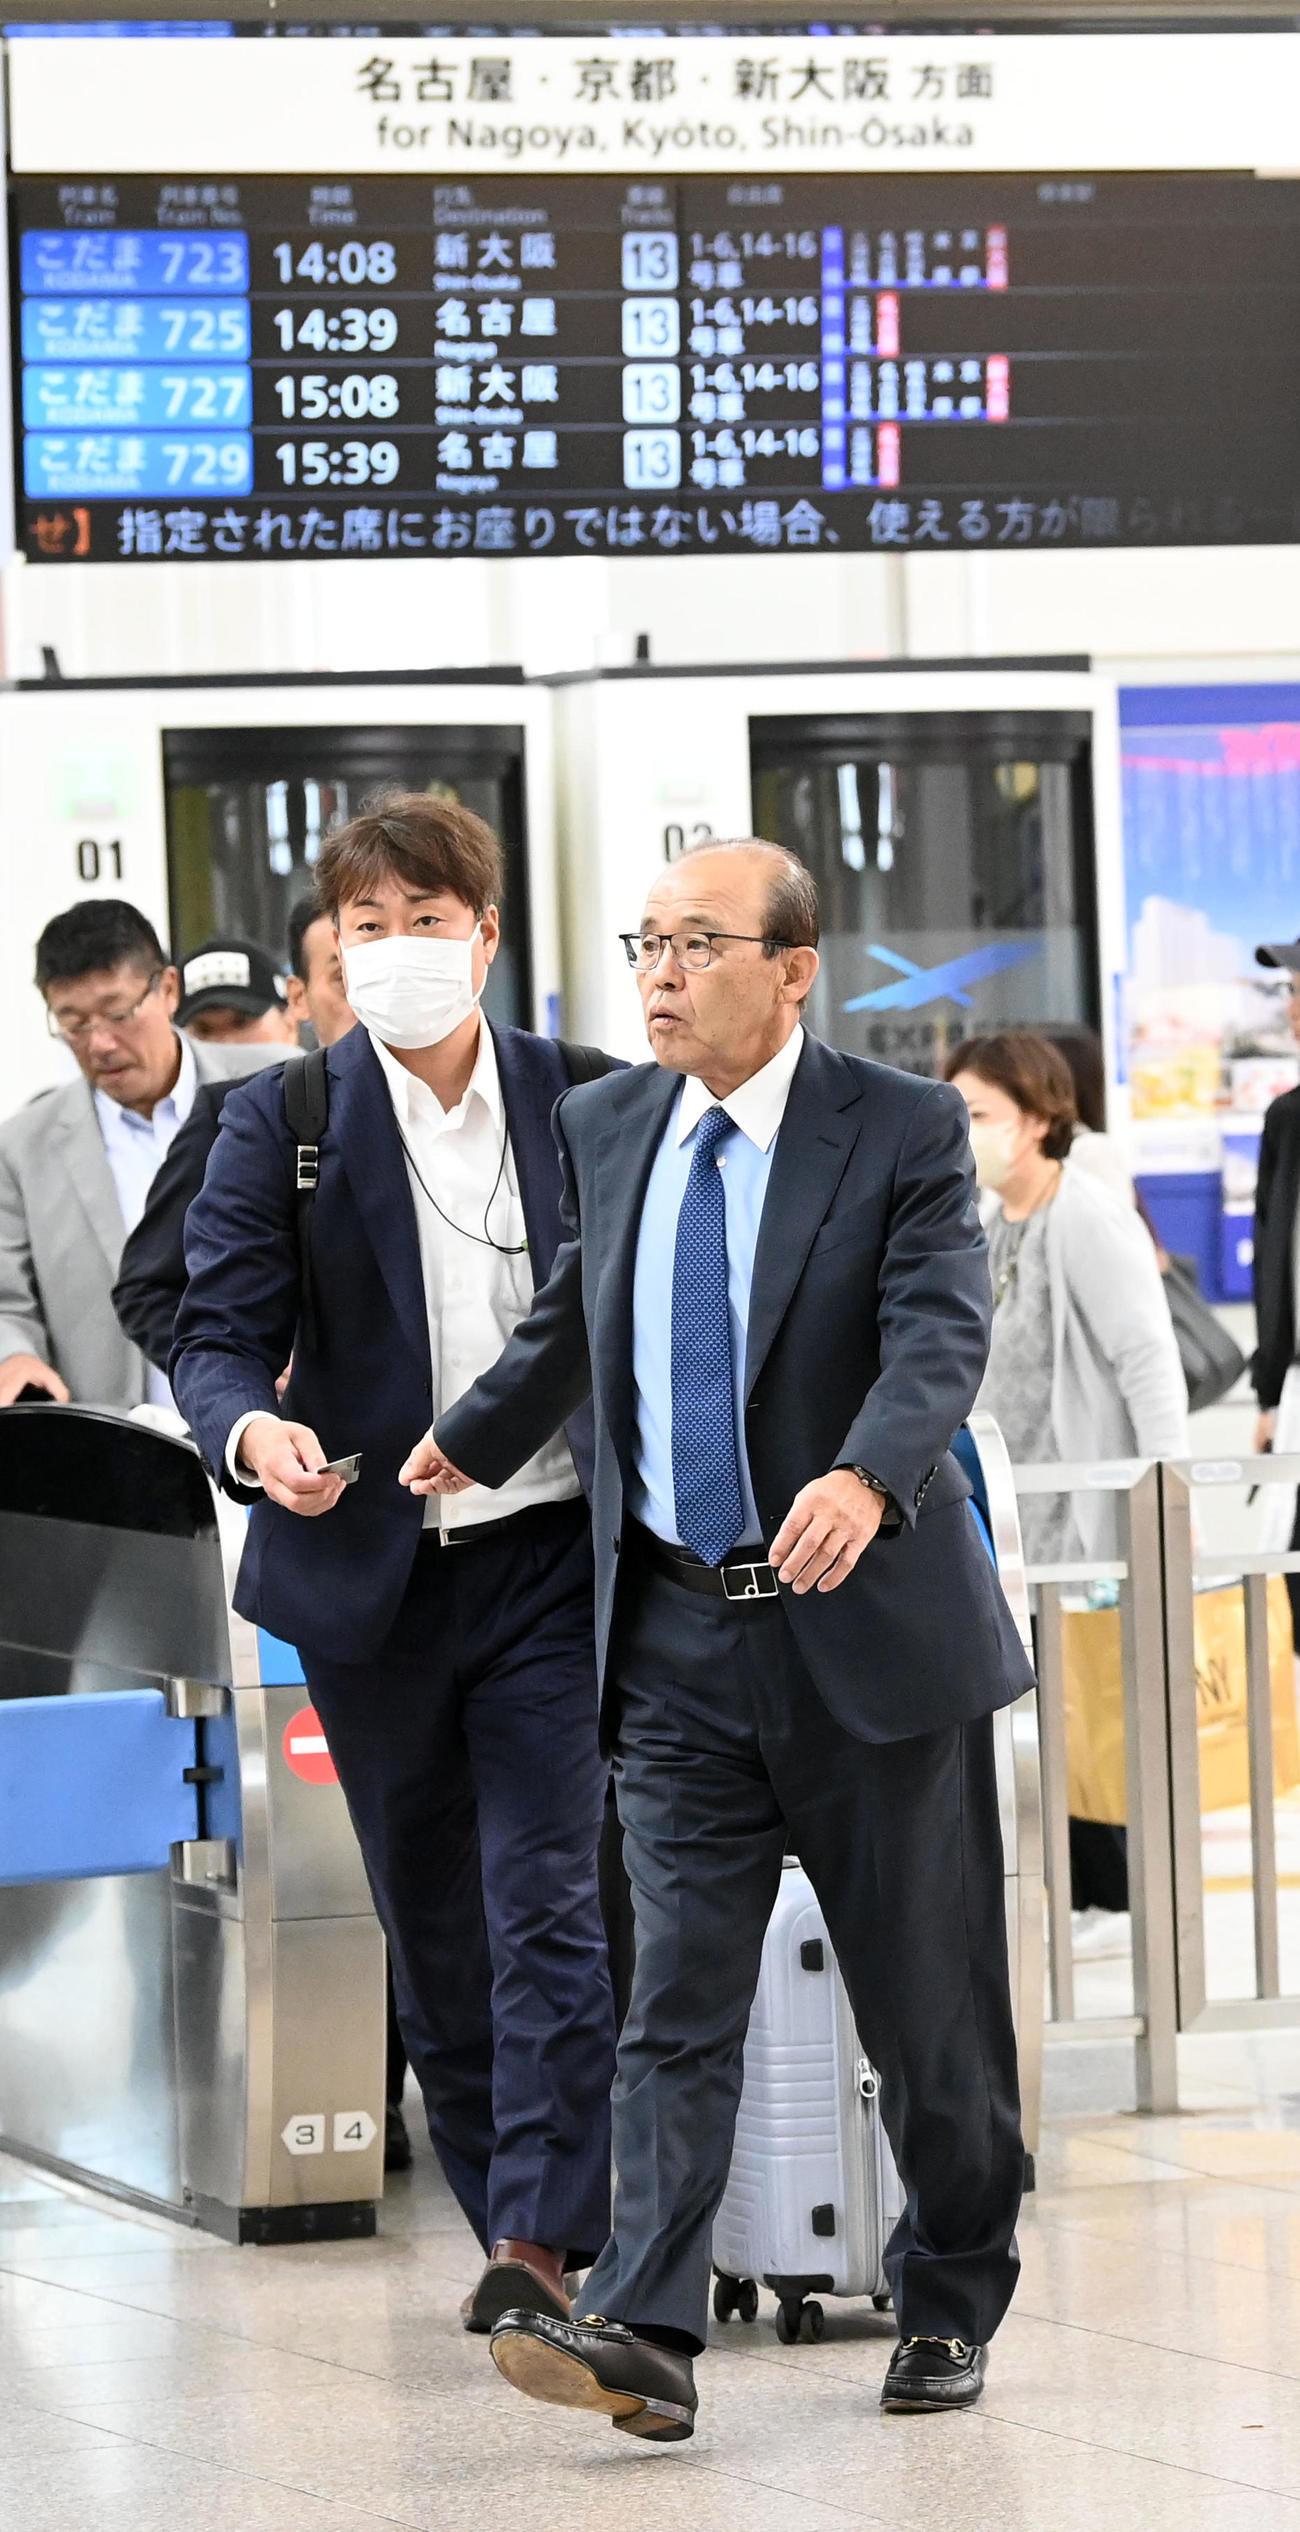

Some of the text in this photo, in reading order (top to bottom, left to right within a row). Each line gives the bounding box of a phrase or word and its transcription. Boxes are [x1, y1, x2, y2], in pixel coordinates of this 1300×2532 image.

[911, 63, 992, 99] 方面
[377, 116, 430, 148] for
[448, 118, 606, 157] Nagoya,
[36, 236, 142, 273] こだま
[159, 242, 245, 284] 723
[273, 242, 397, 284] 14:08
[434, 232, 556, 268] 新大阪
[630, 241, 670, 280] 13
[37, 302, 144, 338] こだま
[160, 309, 246, 351] 725
[274, 308, 398, 351] 14:39
[436, 298, 557, 337] 名古屋
[632, 307, 670, 346] 13
[39, 369, 145, 405] こだま
[161, 376, 247, 418] 727
[275, 375, 399, 419] 15:08
[436, 364, 558, 403] 新大阪
[633, 373, 671, 413] 13
[40, 436, 146, 472] こだま
[162, 443, 248, 485] 729
[276, 442, 400, 486] 15:39
[438, 431, 558, 469] 名古屋
[634, 440, 671, 479] 13
[78, 840, 122, 881] 01
[664, 824, 712, 863] 0
[295, 2121, 363, 2146] 3 4
